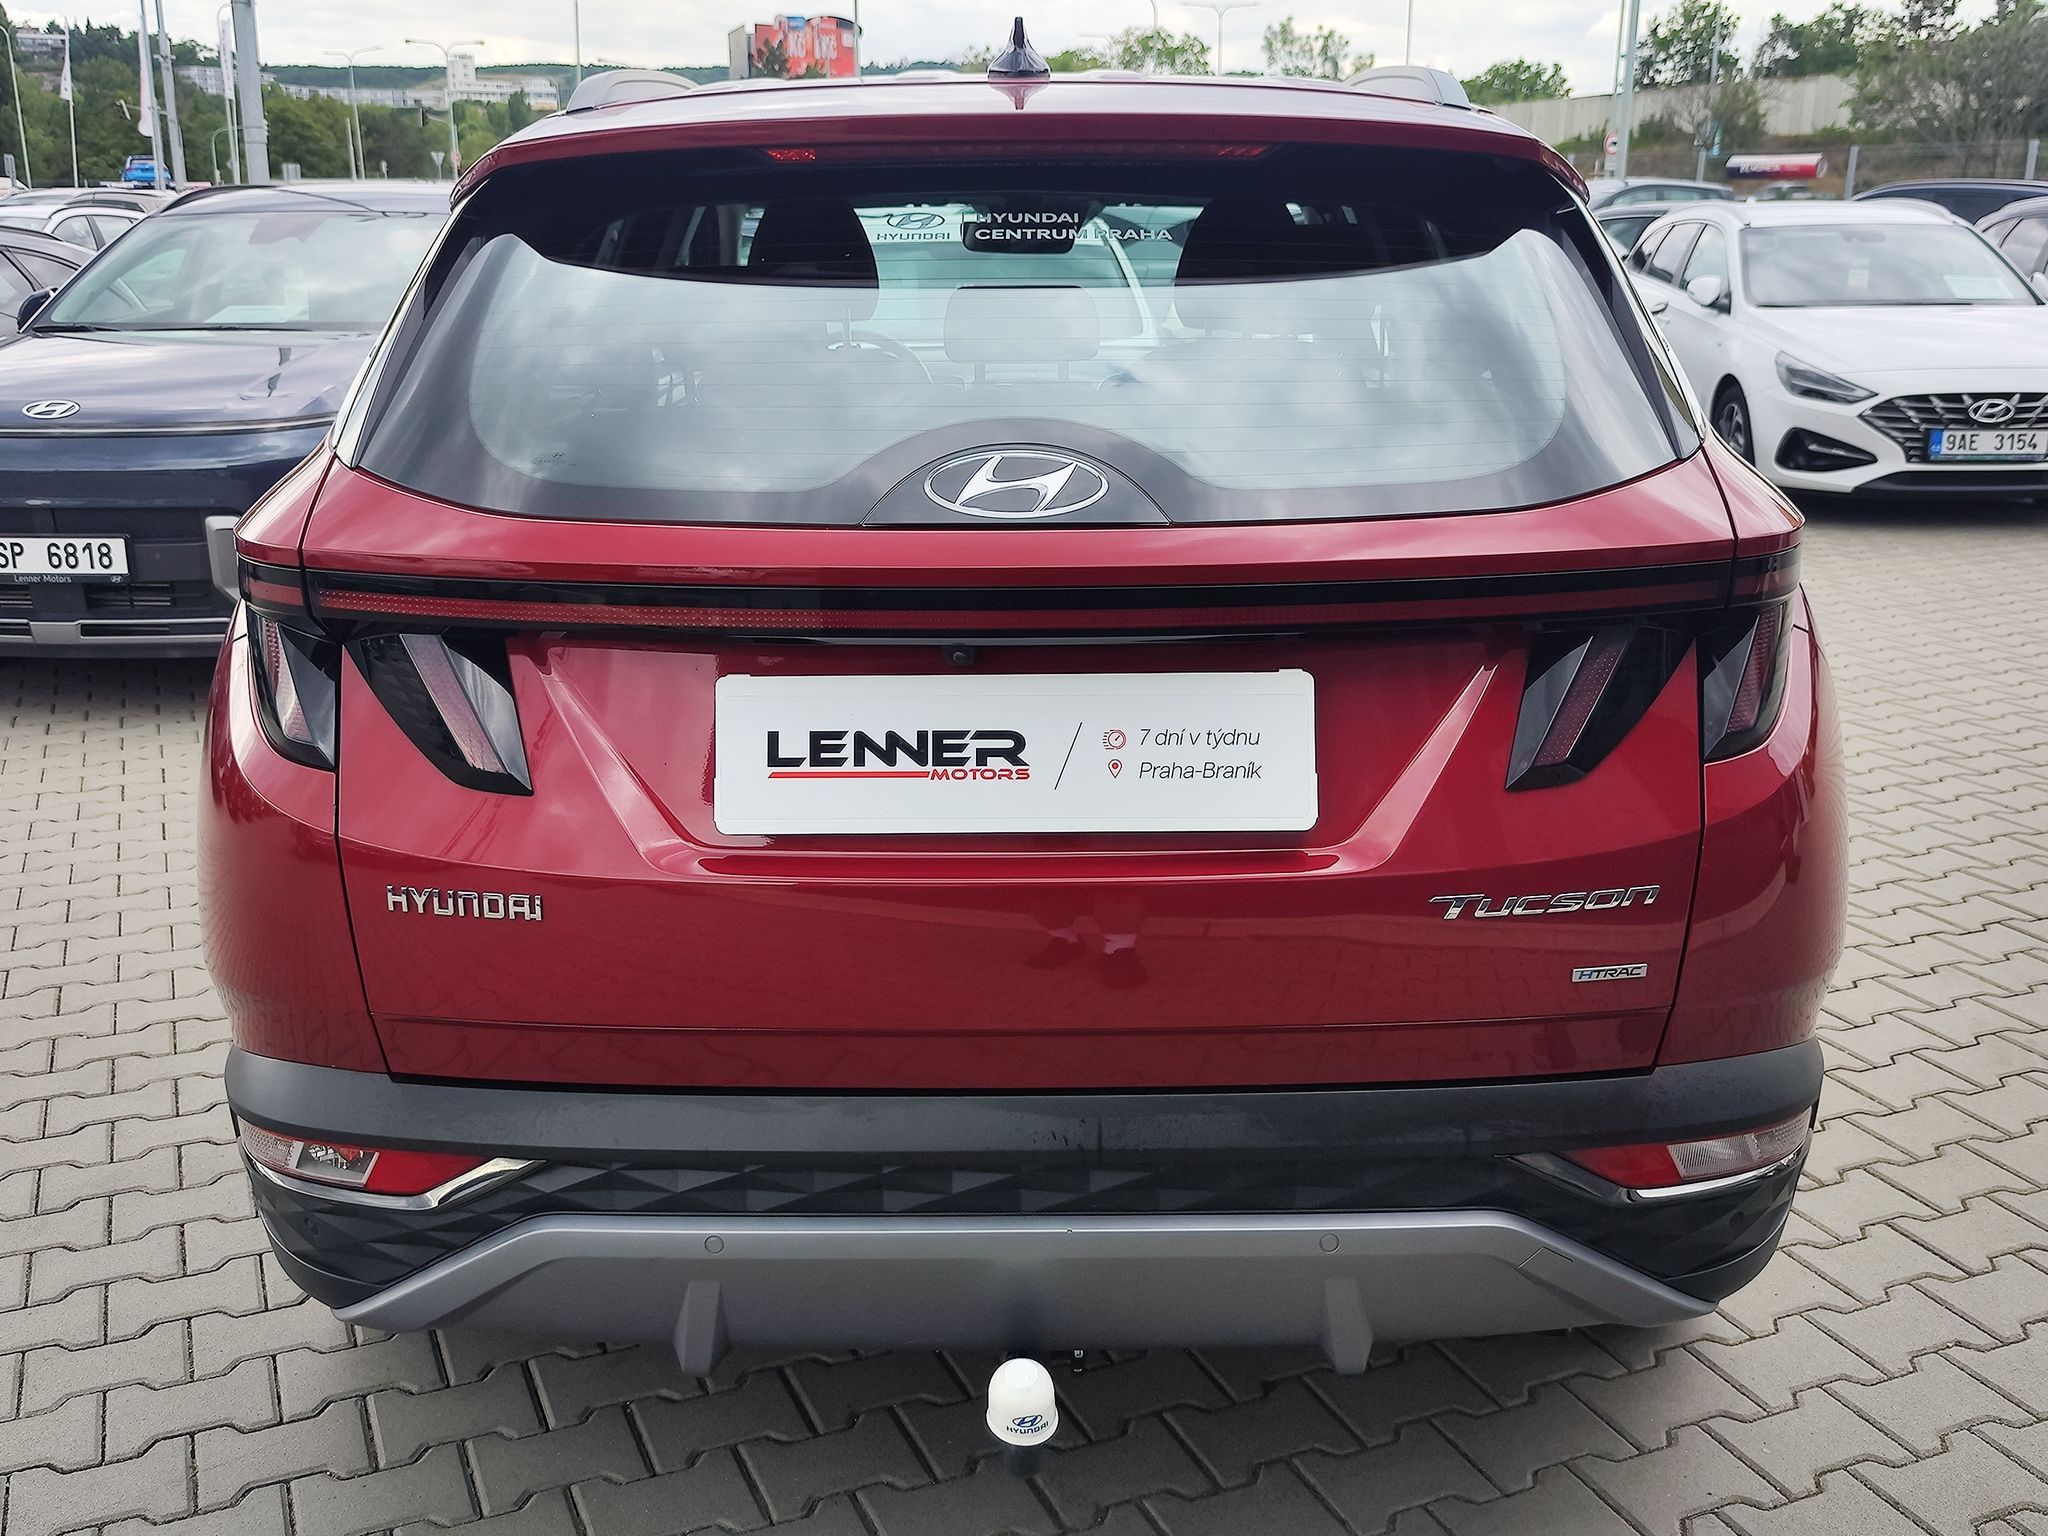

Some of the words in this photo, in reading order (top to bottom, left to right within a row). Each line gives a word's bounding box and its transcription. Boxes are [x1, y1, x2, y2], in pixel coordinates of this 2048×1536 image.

[976, 212, 1078, 223] HYUNDAI
[877, 232, 950, 240] HYUNDAI
[974, 228, 1088, 240] CENTRUM
[1095, 228, 1173, 240] PRAHA
[1946, 433, 1979, 451] 9AE
[1994, 433, 2037, 451] 3154
[47, 542, 113, 569] 6818
[14, 574, 41, 583] Lenner
[43, 574, 72, 583] Motors
[1139, 728, 1150, 746] 7
[1155, 727, 1186, 746] dní
[1189, 733, 1200, 746] v
[1205, 728, 1260, 750] týdnu
[767, 730, 1028, 767] LENNER
[930, 769, 1030, 780] MOTORS
[1138, 760, 1262, 780] Praha-Braník
[386, 885, 542, 921] HYUNDAI
[1577, 965, 1642, 980] HTRAC
[1006, 1421, 1049, 1434] HYUNDAI
